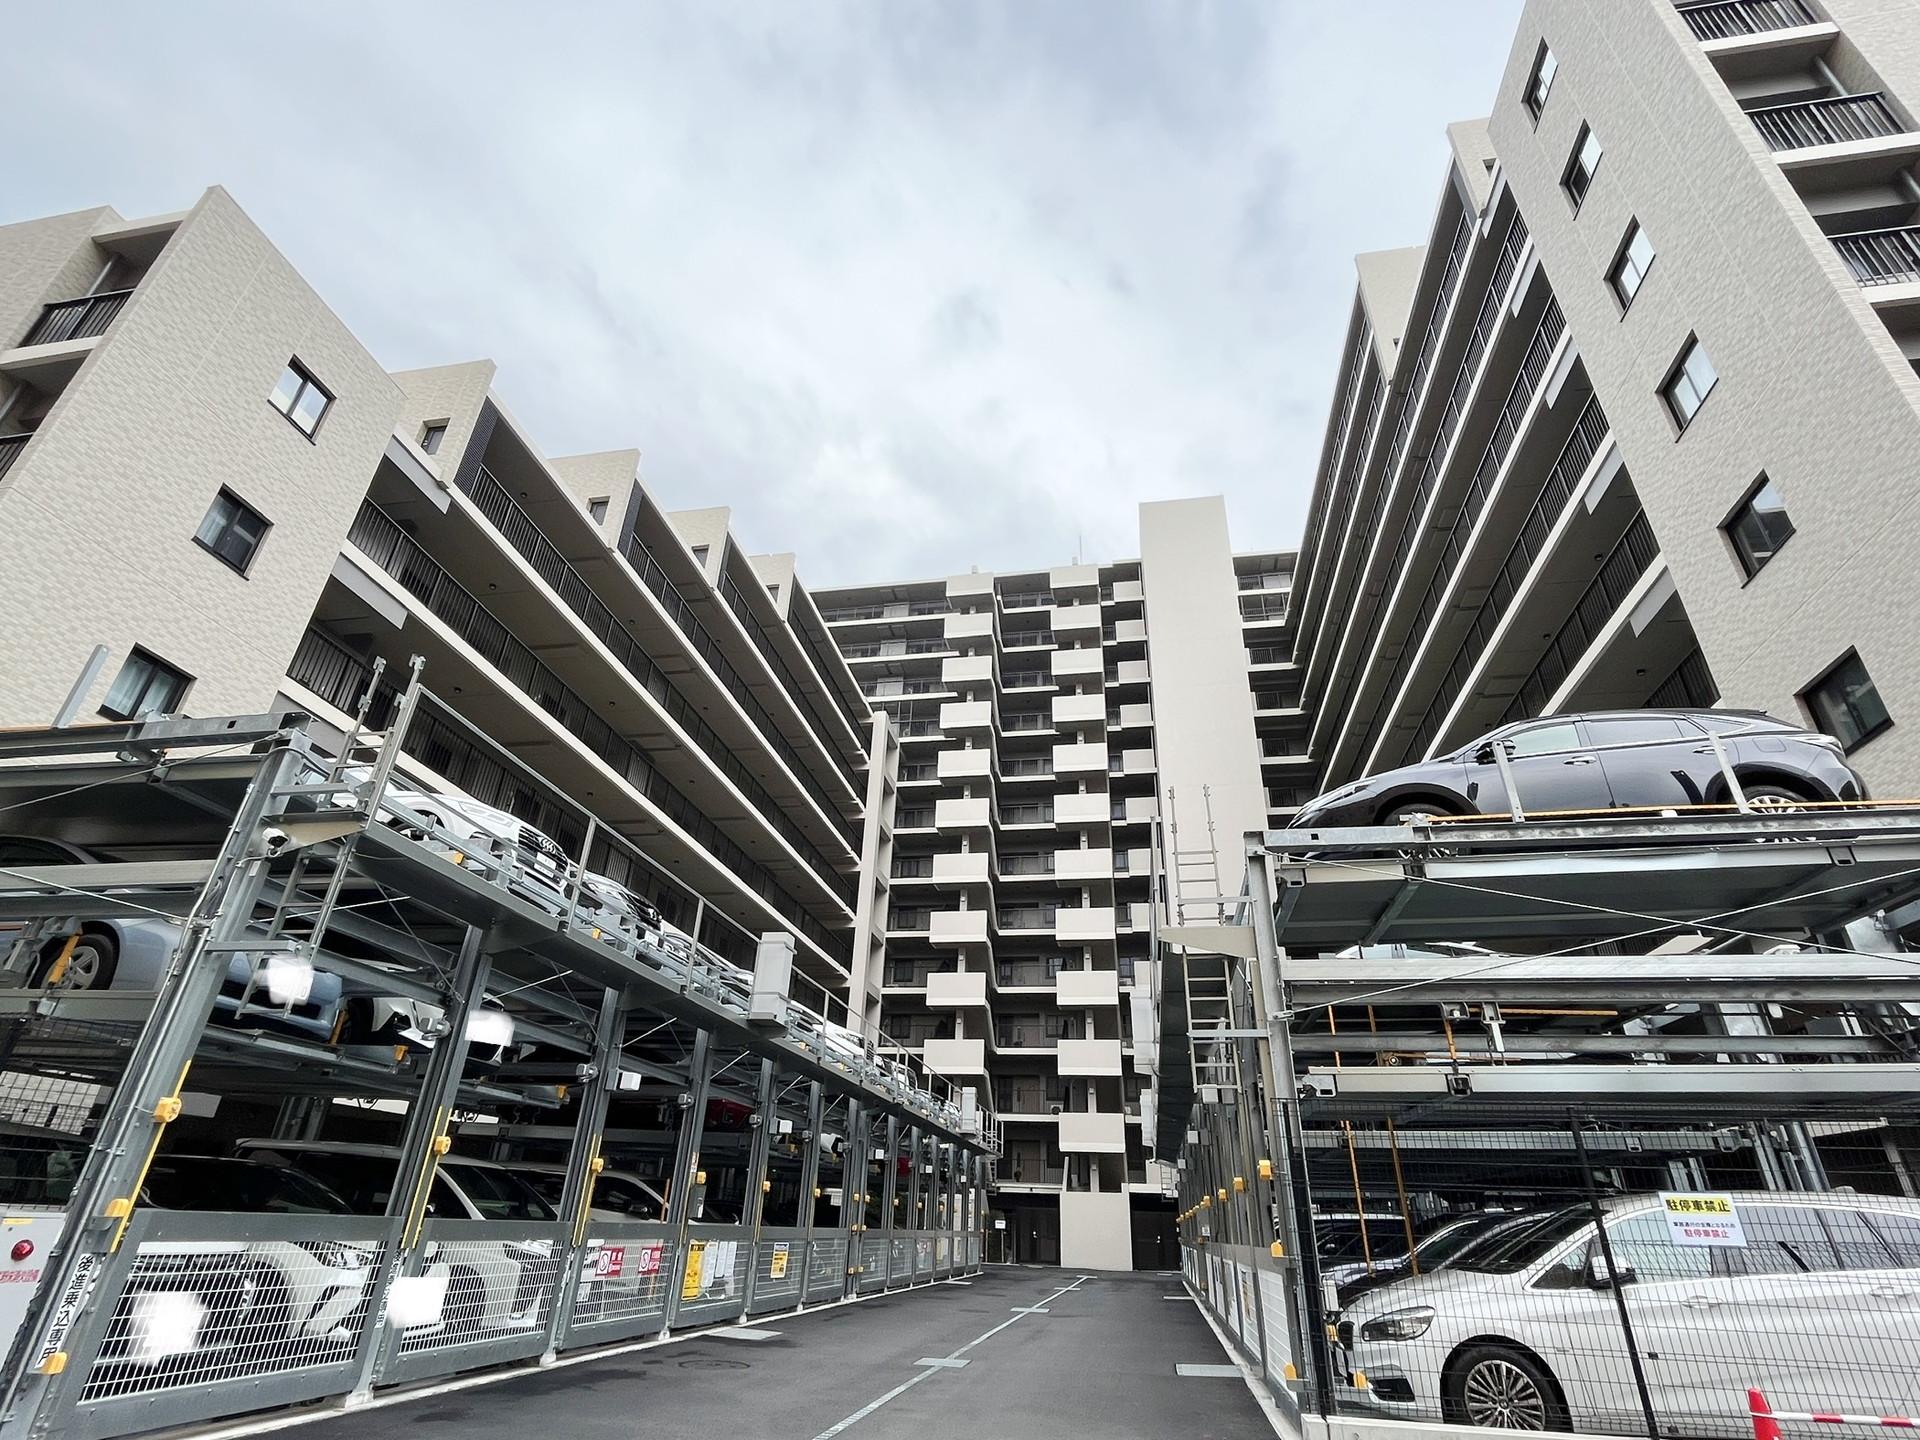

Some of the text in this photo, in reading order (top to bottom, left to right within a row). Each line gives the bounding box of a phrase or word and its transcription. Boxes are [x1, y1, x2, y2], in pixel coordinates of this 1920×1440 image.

[1665, 1199, 1731, 1212] 駐停車禁止
[1684, 1229, 1730, 1239] 駐停車禁止
